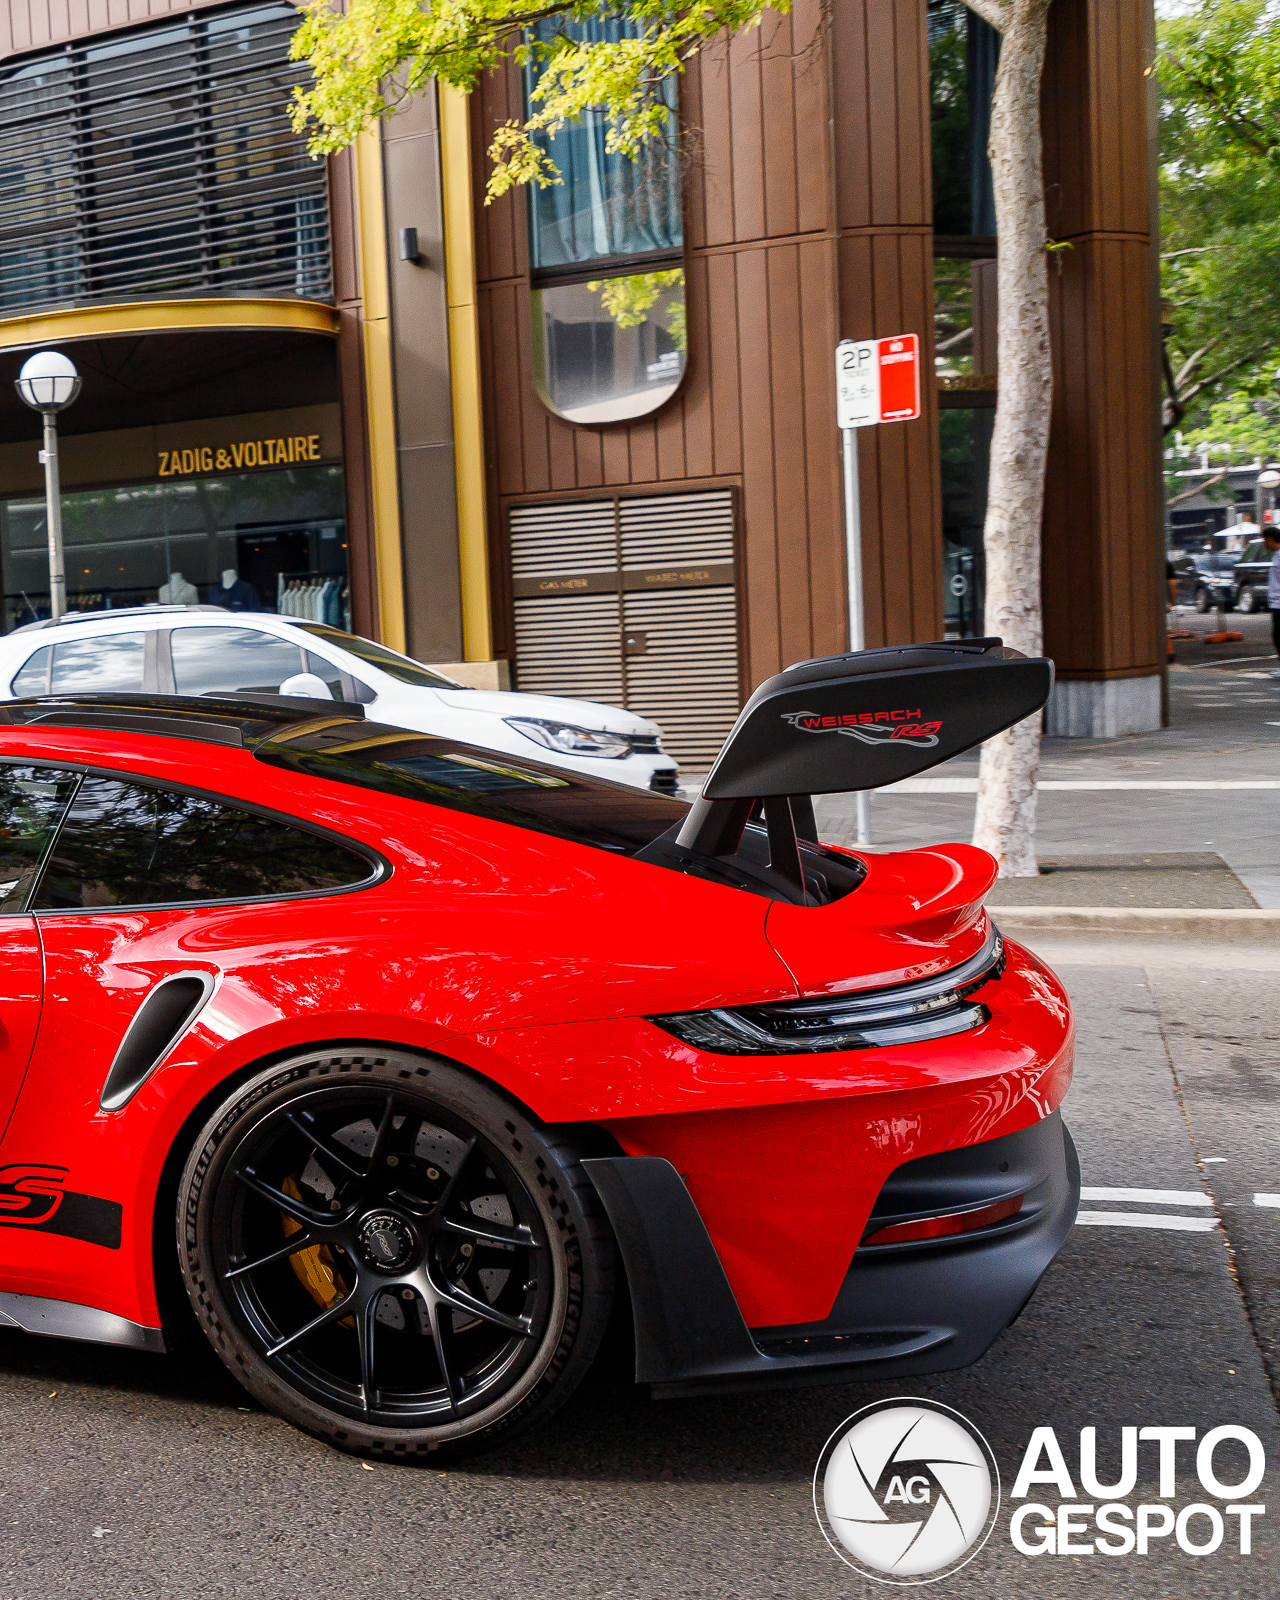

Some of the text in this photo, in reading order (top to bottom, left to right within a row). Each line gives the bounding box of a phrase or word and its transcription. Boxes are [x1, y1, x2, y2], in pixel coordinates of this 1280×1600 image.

[841, 347, 872, 371] 2P
[803, 708, 922, 729] WEISSACH
[889, 720, 944, 739] RS
[186, 1138, 217, 1244] MICHELIN
